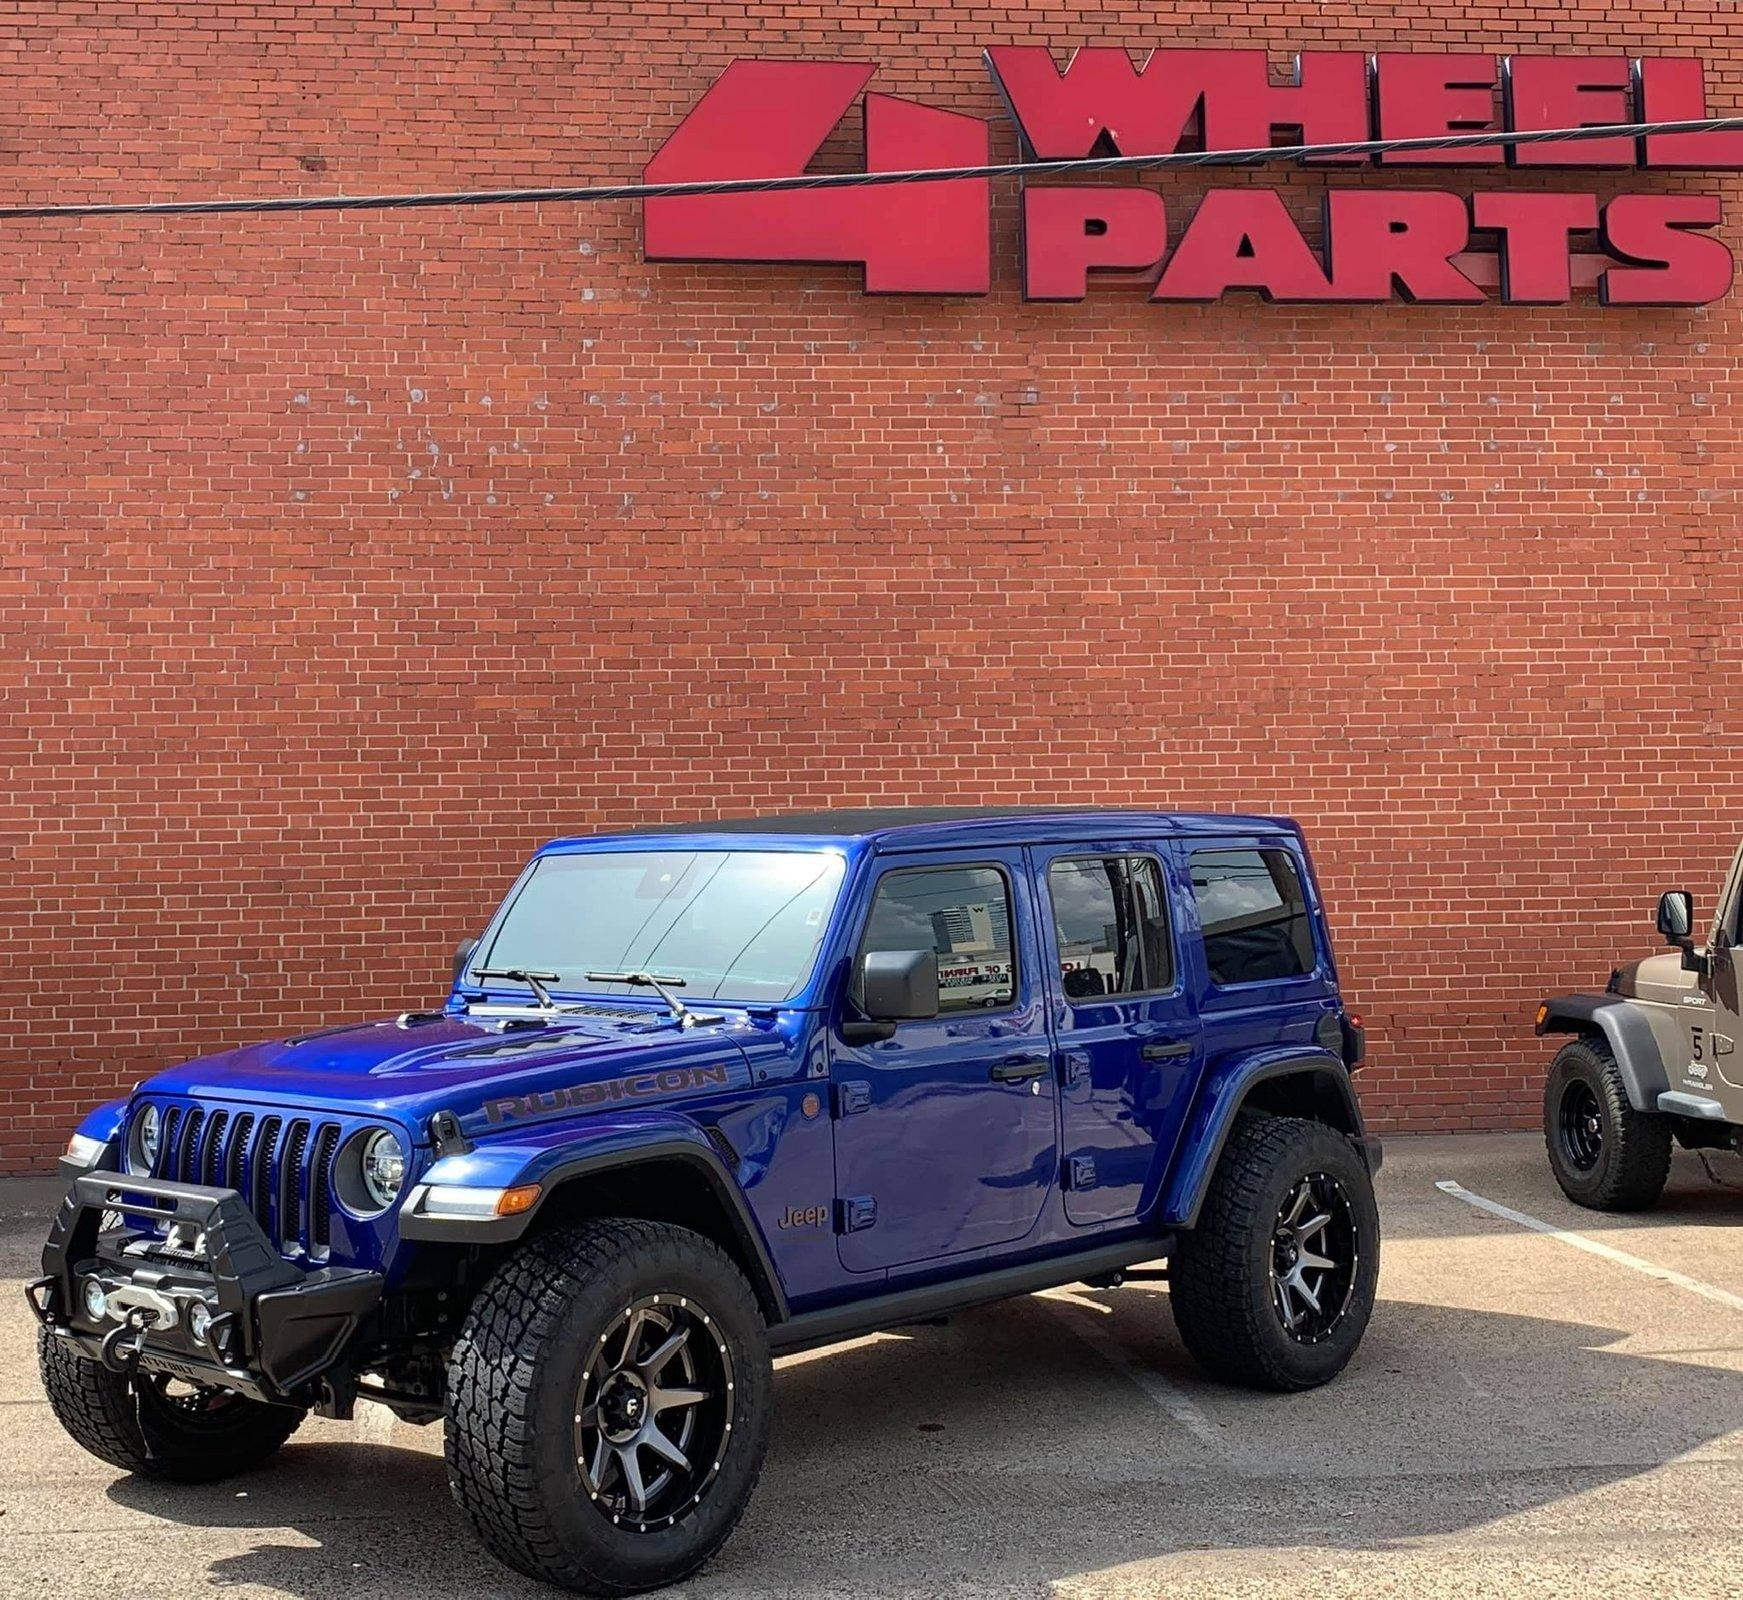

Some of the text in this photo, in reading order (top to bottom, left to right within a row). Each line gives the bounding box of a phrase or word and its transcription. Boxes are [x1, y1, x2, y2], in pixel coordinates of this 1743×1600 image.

[984, 46, 1743, 170] WHEEL
[643, 58, 989, 295] 4
[1023, 187, 1734, 305] PARTS
[1683, 996, 1706, 1005] SPORT
[483, 1064, 727, 1123] RUBICON
[1688, 1061, 1708, 1079] Jeep
[778, 1205, 829, 1230] Jeep
